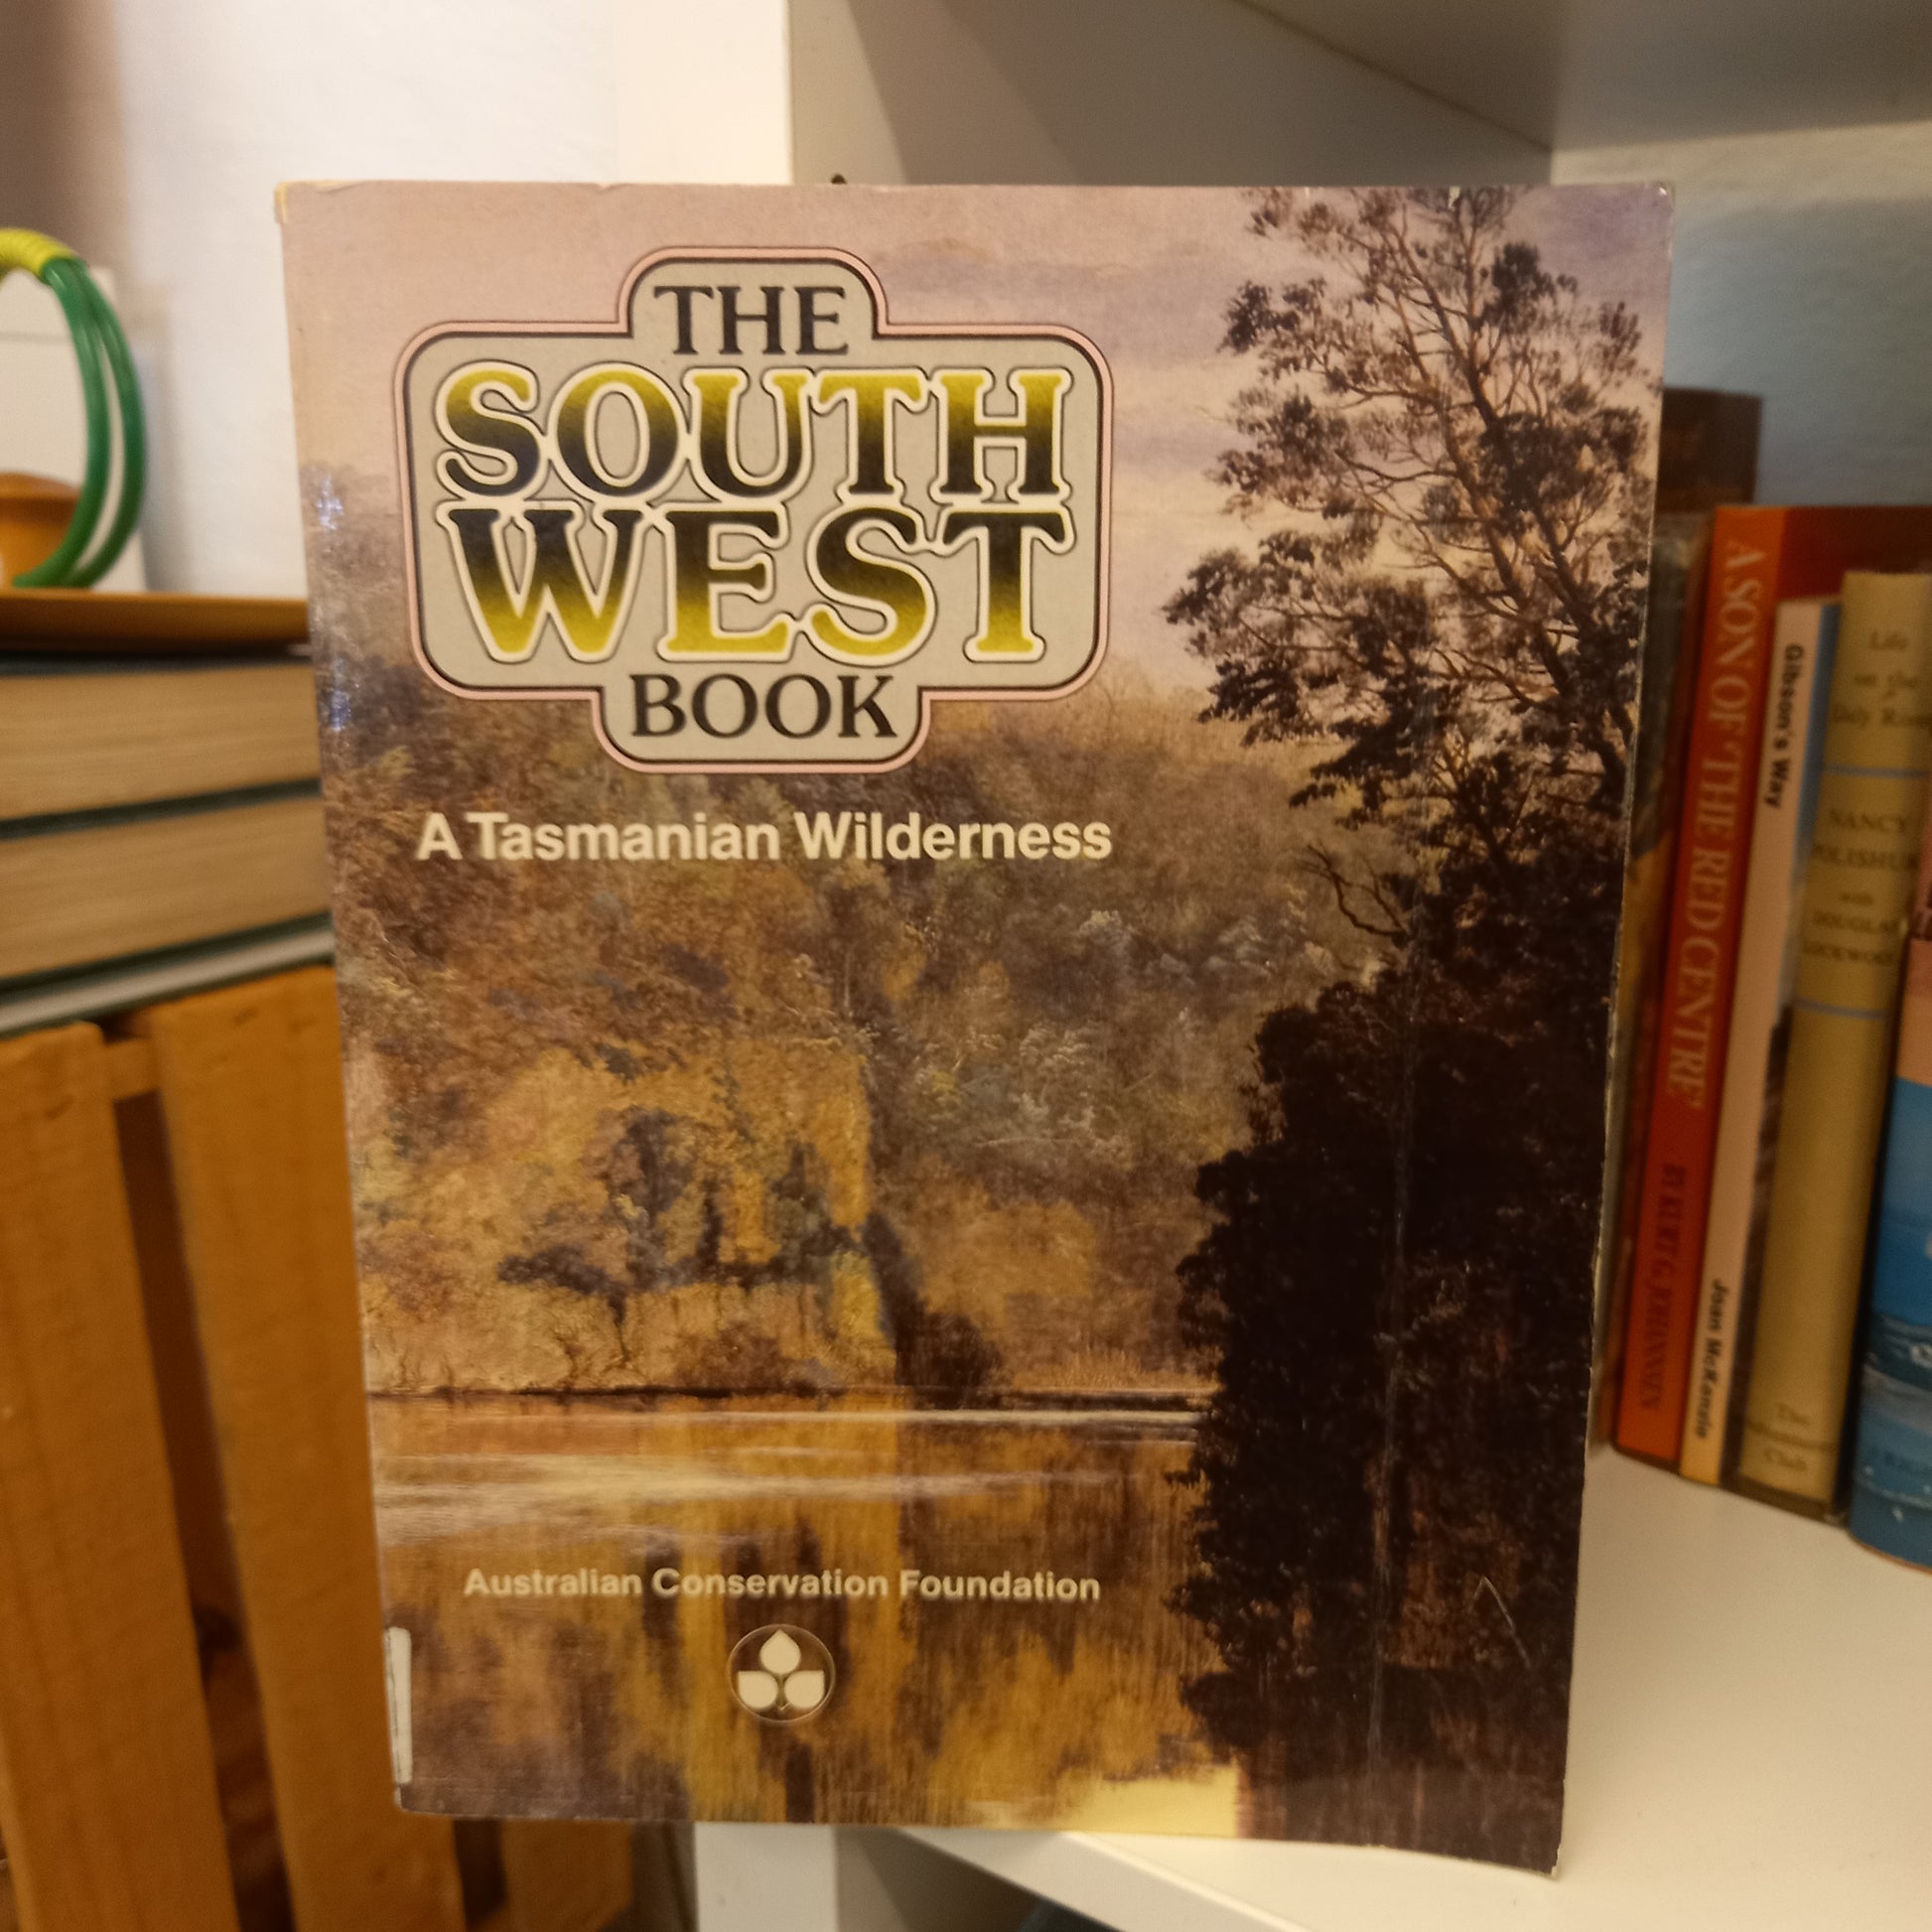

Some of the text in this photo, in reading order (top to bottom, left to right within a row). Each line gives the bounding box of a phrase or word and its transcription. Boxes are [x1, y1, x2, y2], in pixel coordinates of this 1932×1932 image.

[653, 285, 849, 355] THE
[438, 364, 1072, 502] SOUTH
[440, 504, 1075, 664] WEST
[1724, 539, 1767, 569] A
[1715, 575, 1764, 670] SON
[631, 673, 898, 740] BOOK
[1707, 675, 1753, 737] OF
[1763, 757, 1790, 809] Way
[416, 810, 1113, 862] A Tasmanian Wilderness
[1685, 848, 1732, 931] RED
[463, 1566, 1102, 1603] Australian Conservation Foundation
